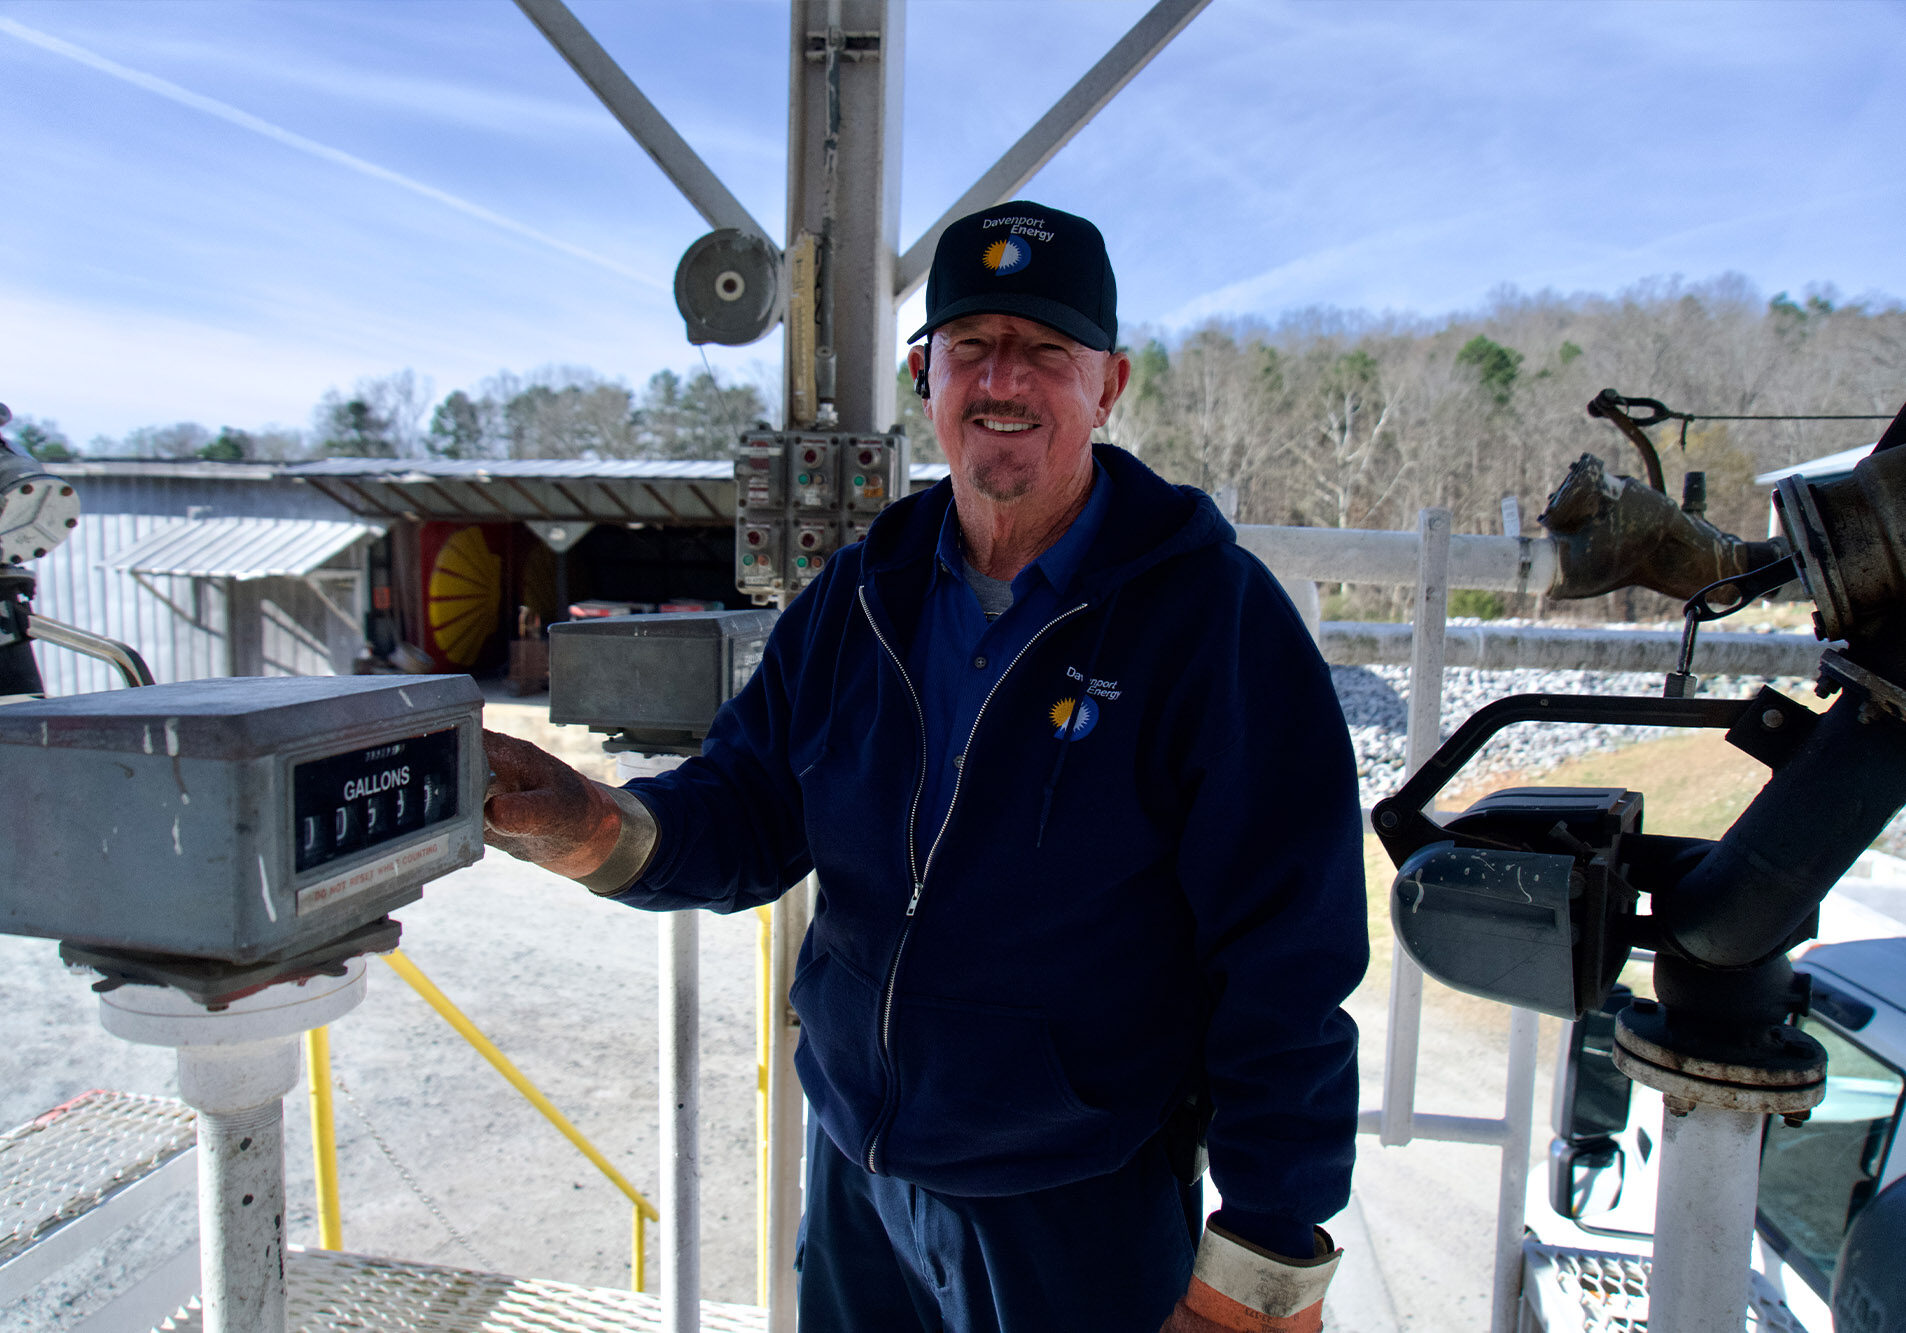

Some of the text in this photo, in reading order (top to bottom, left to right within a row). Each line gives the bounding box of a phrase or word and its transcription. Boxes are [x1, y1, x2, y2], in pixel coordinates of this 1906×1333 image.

[983, 216, 1045, 229] Davenport
[1010, 224, 1055, 242] Energy
[1066, 666, 1118, 689] Danport
[1086, 686, 1121, 700] Energy
[344, 766, 410, 801] GALLONS
[314, 889, 327, 901] DO
[329, 880, 346, 896] NOT
[349, 870, 374, 888] RESET
[402, 844, 438, 864] COUNTING
